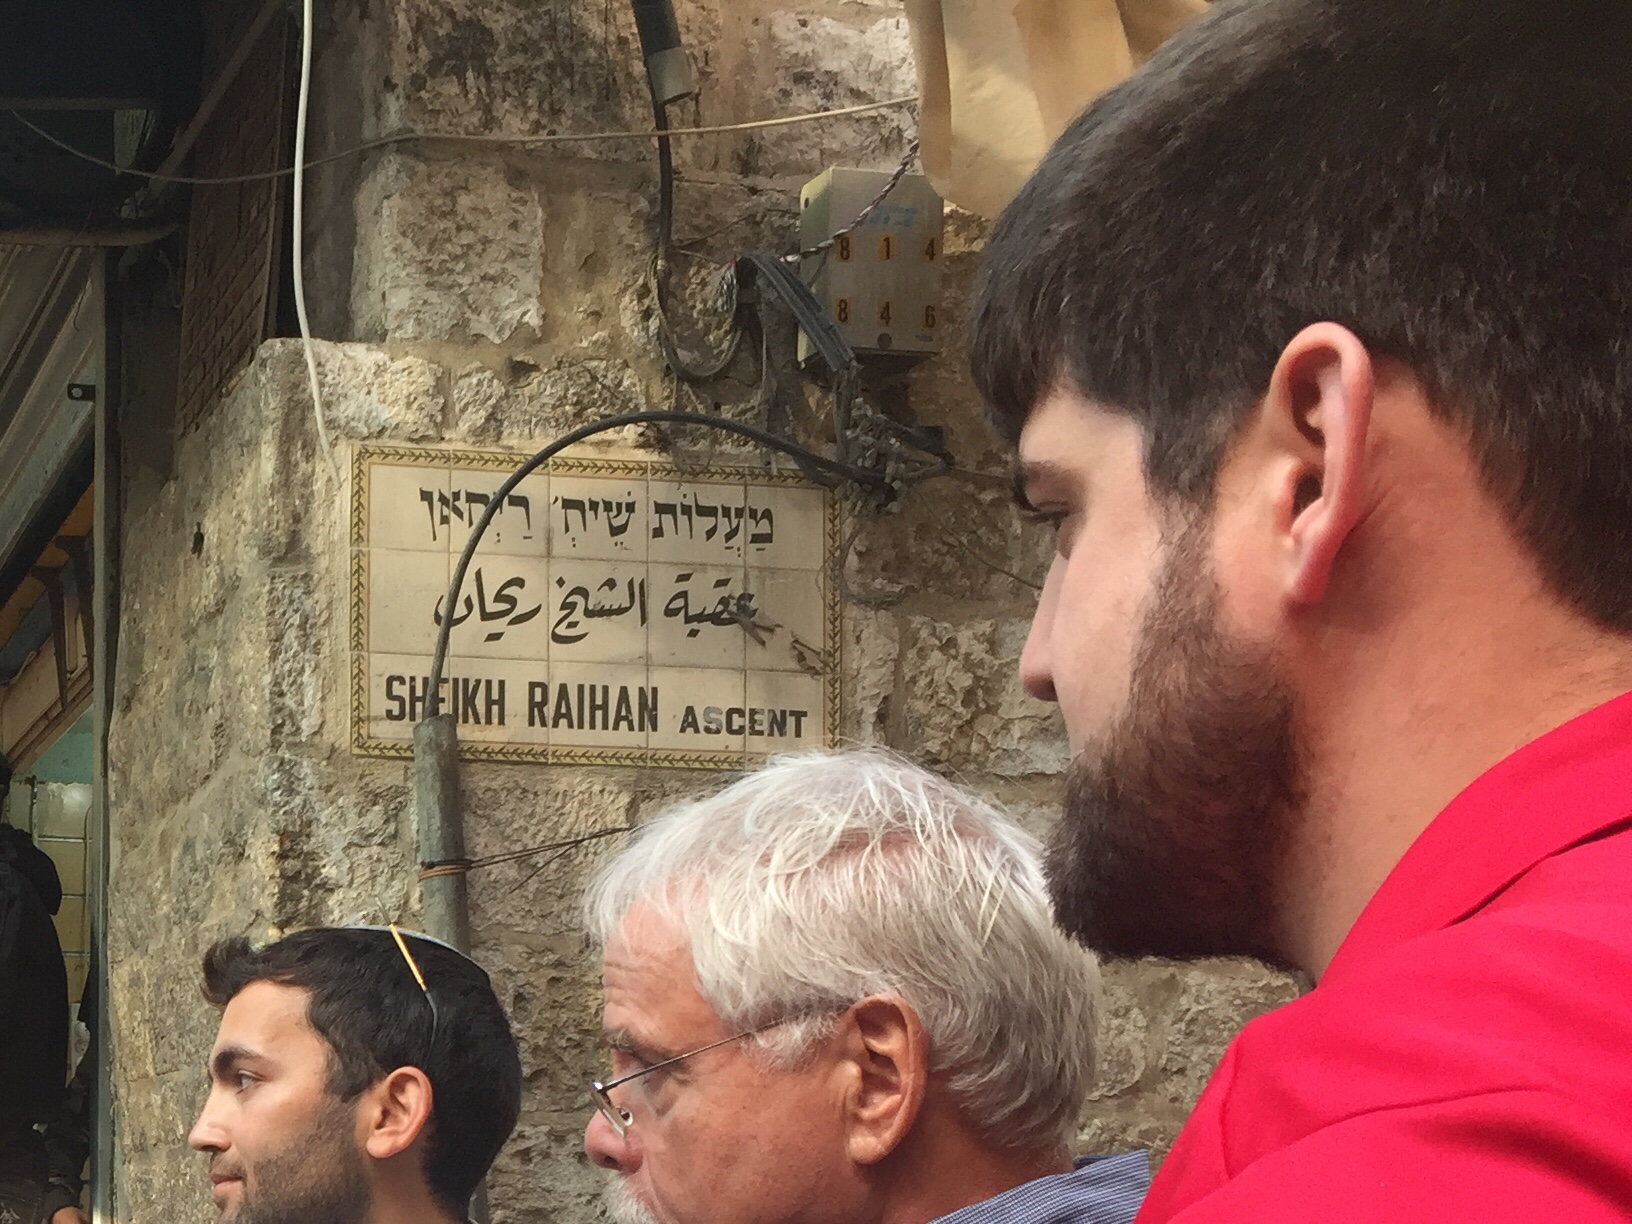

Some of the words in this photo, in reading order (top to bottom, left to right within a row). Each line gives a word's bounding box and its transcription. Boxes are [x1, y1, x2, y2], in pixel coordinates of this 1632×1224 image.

[883, 237, 891, 260] 1
[880, 301, 891, 326] 4
[925, 305, 936, 328] 6
[551, 576, 647, 644] الشيخ
[663, 572, 759, 638] عقبة
[385, 674, 506, 725] SHEIKH
[528, 681, 658, 732] RAIHAN
[678, 705, 808, 738] ASCENT
